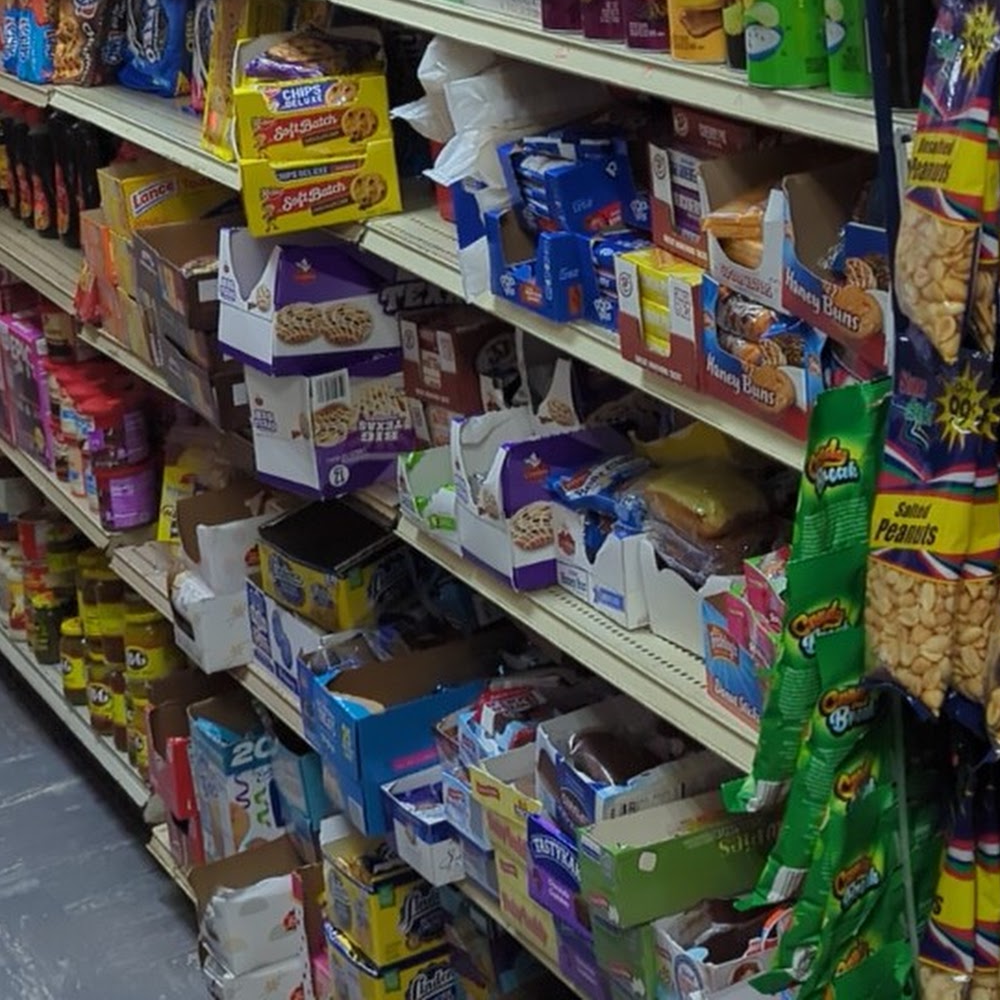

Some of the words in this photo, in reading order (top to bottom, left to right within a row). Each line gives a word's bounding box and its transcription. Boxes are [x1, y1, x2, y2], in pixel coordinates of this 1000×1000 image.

[282, 84, 322, 102] CHIPS
[273, 121, 300, 142] Soft
[300, 113, 338, 132] Batch
[131, 179, 175, 209] Lance
[282, 194, 309, 211] Soft
[309, 181, 346, 201] Batch
[784, 268, 823, 316] Honey
[822, 296, 861, 333] Buns
[706, 353, 741, 393] Honey
[741, 376, 777, 406] Buns
[894, 501, 931, 520] Salted
[875, 519, 938, 546] Peanuts
[531, 834, 582, 883] TASTYKA
